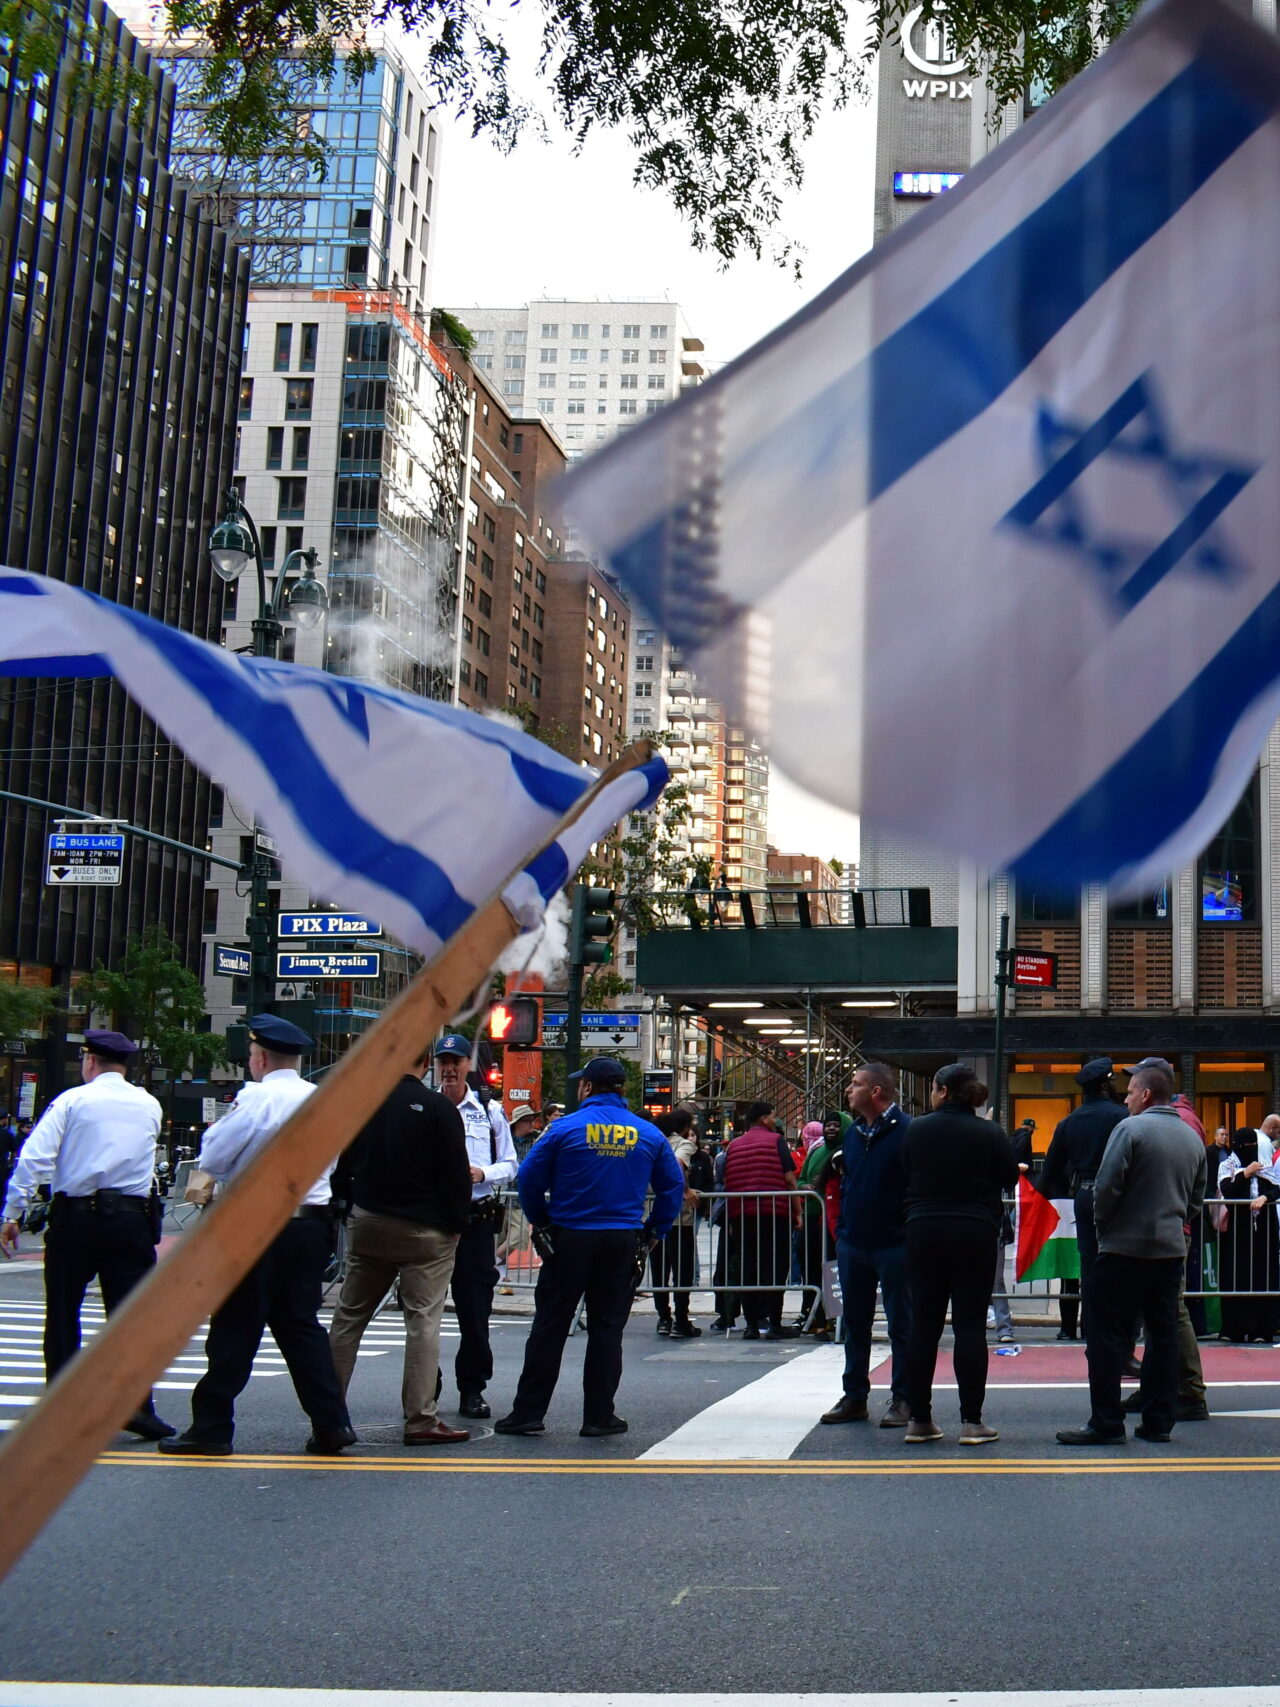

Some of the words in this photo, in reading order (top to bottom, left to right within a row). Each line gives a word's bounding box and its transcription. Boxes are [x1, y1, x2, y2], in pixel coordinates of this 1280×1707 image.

[902, 80, 972, 98] WPIX
[70, 838, 88, 847] BUS
[91, 838, 117, 847] LANE
[72, 867, 95, 875] BUSES
[99, 867, 117, 875] ONLY
[292, 918, 322, 932] PIX
[327, 918, 368, 931] Plaza
[219, 952, 239, 970] Second
[239, 956, 249, 971] Ave
[289, 956, 325, 969] Jimmy
[328, 956, 368, 966] Breslin
[1025, 956, 1048, 965] STANDING
[321, 966, 341, 975] Way
[1017, 963, 1037, 971] Anytime
[581, 1016, 604, 1024] LANE
[509, 1088, 531, 1100] GENIE
[586, 1123, 639, 1146] NYPD
[588, 1142, 635, 1151] COMMUNITY
[597, 1149, 626, 1158] AFFAIRS
